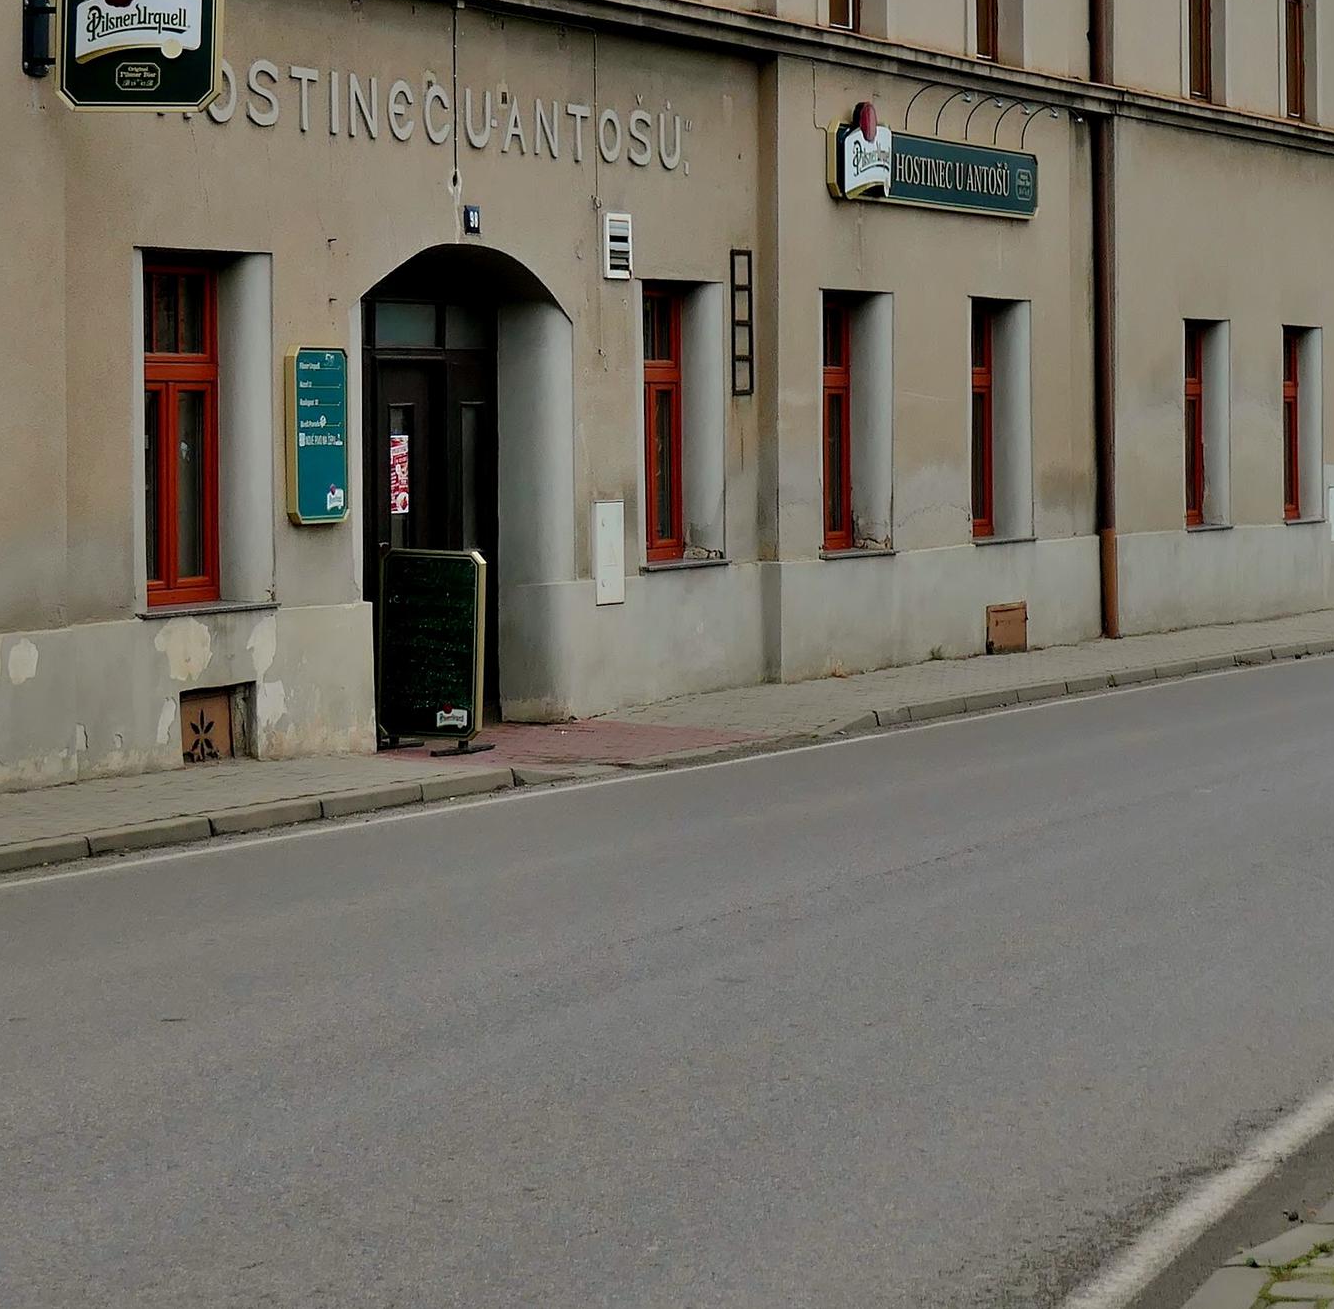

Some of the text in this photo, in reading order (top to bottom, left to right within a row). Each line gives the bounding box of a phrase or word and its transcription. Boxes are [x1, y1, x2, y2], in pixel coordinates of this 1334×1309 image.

[86, 3, 187, 42] Pilsner Urquell
[207, 59, 452, 144] OSTINEC
[894, 153, 952, 190] HOSTINEC
[955, 162, 964, 191] U
[967, 161, 1010, 197] ANTOŠŮ
